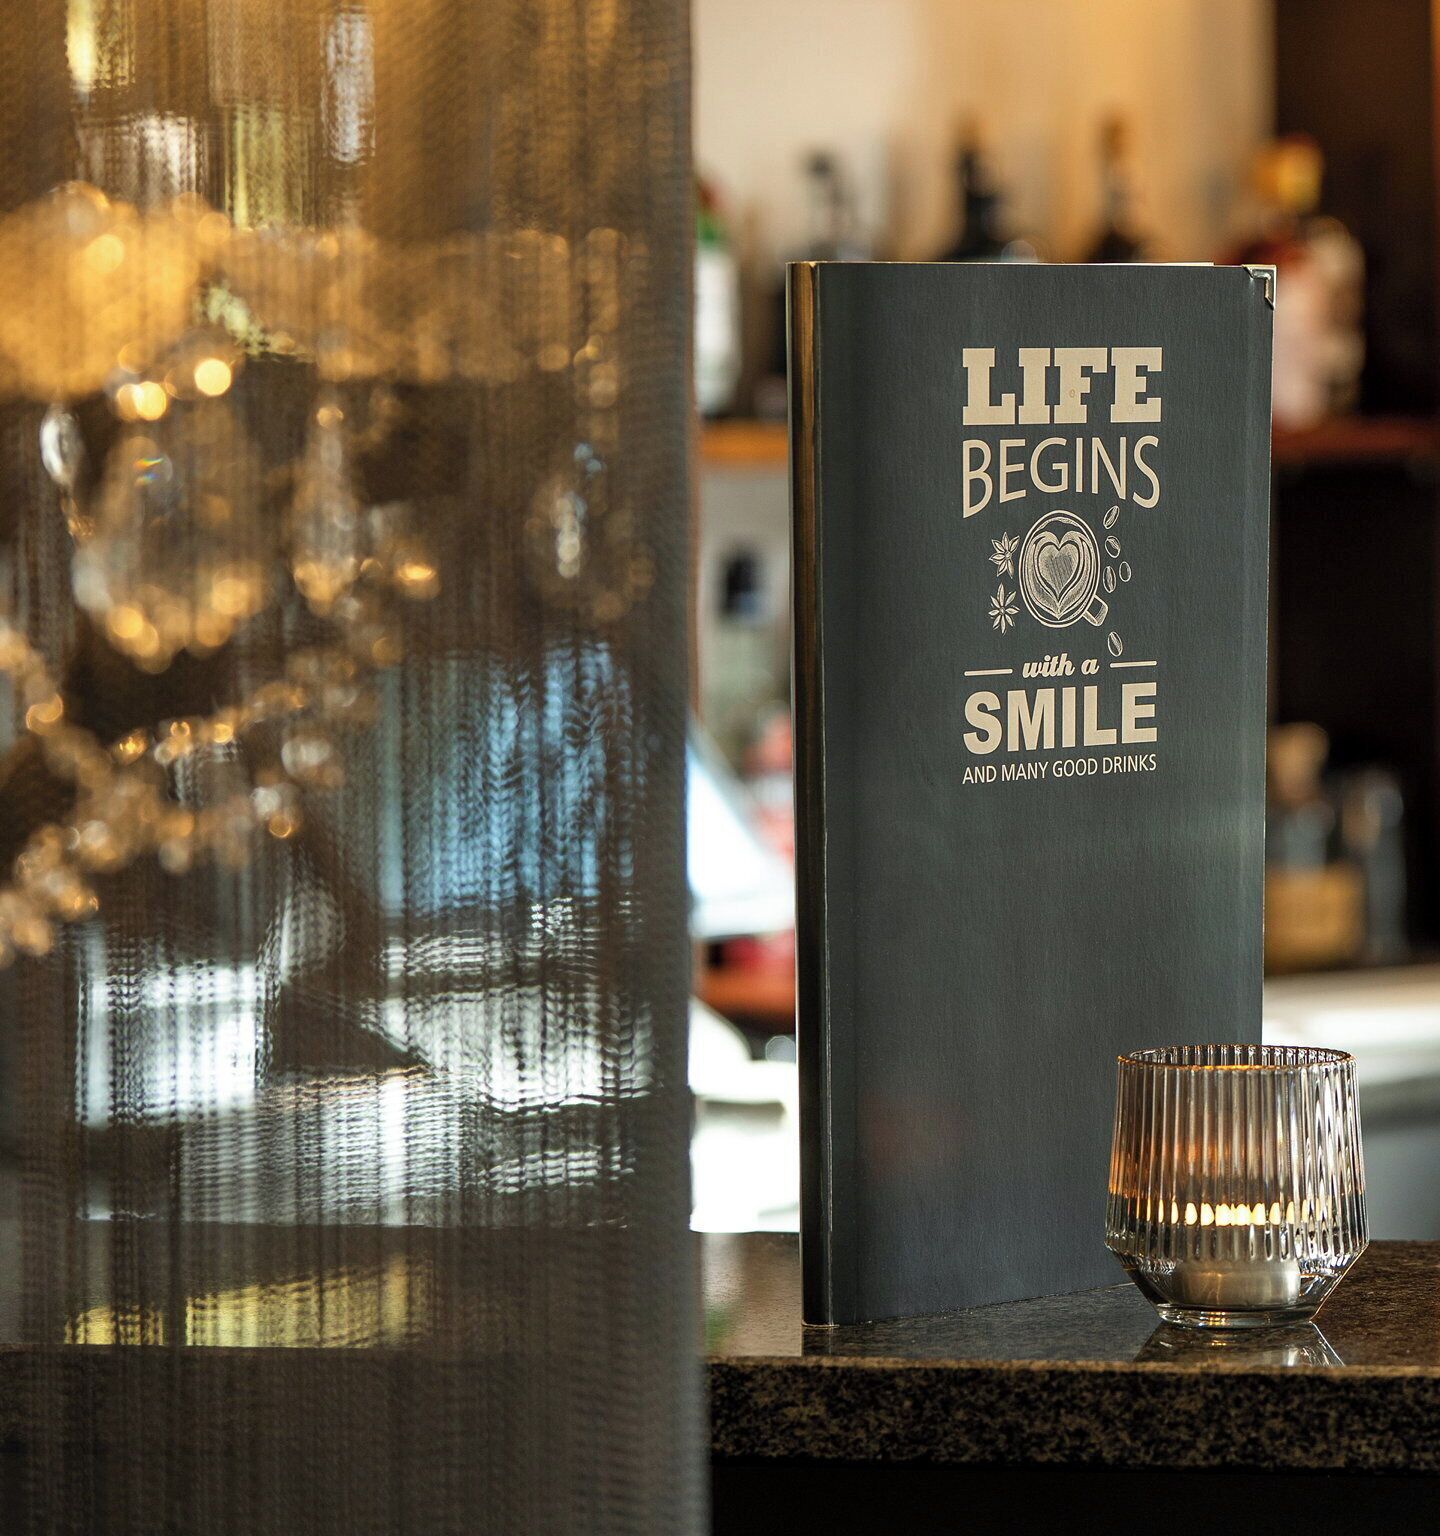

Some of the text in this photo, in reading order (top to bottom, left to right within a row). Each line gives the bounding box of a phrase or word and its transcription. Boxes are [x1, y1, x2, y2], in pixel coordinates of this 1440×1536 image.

[962, 347, 1163, 426] LIFE
[962, 435, 1160, 519] BEGINS
[1022, 653, 1100, 679] with a
[963, 682, 1158, 755] SMILE
[962, 753, 1157, 785] AND MANY GOOD DRINKS
